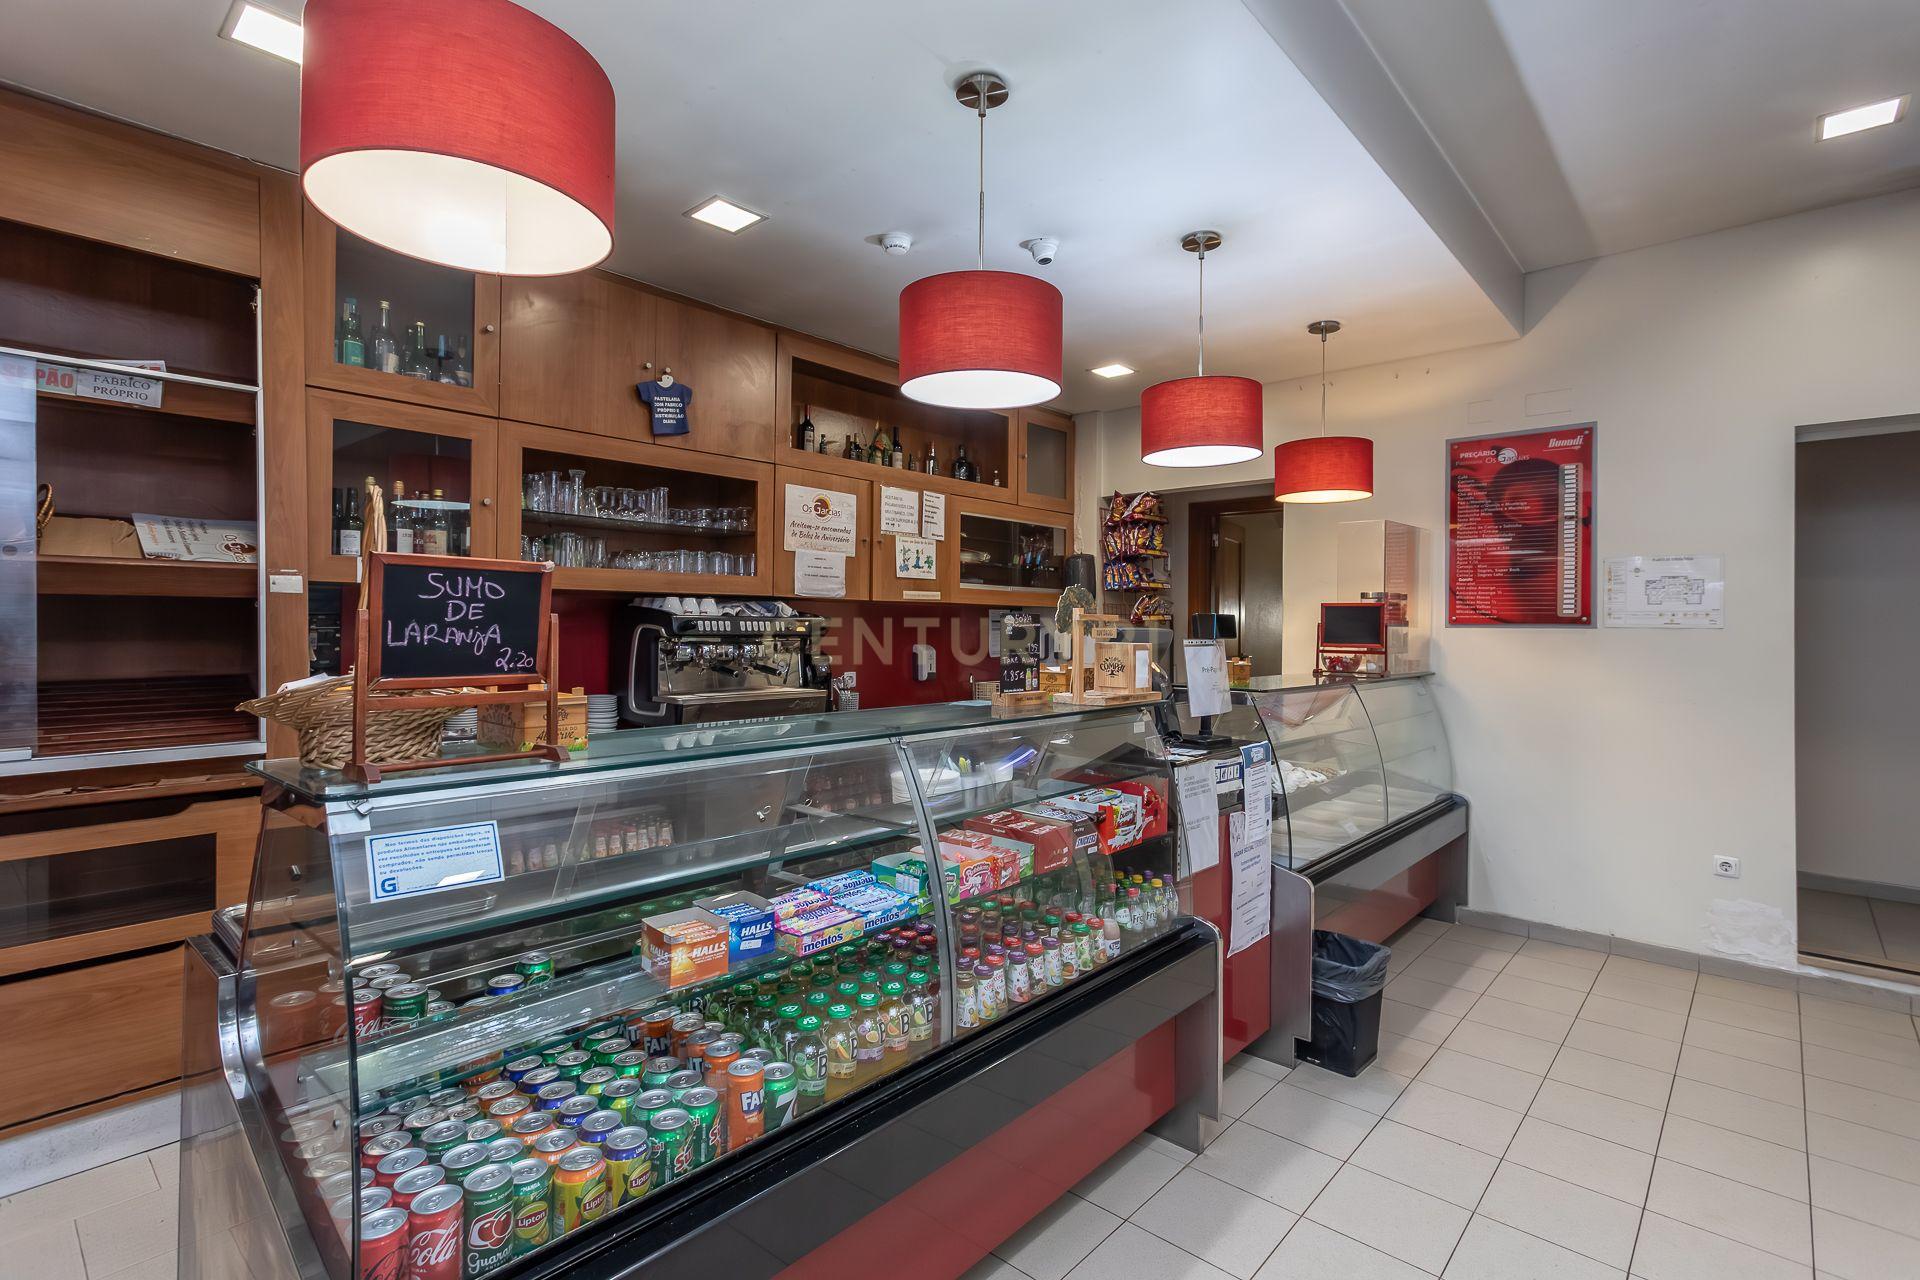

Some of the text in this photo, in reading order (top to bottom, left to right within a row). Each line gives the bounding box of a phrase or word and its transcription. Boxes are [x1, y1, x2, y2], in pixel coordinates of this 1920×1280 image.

[36, 367, 74, 389] PÃO
[93, 374, 150, 391] FABRICO
[93, 385, 148, 400] PRÓPRIO
[802, 502, 841, 517] Os Garcias
[790, 520, 852, 535] Aceitam-se encomendas
[791, 529, 850, 543] de Bolos de Aniversário
[418, 573, 505, 599] SUMO
[445, 600, 485, 622] DE
[387, 620, 501, 655] LARANJA
[380, 876, 397, 893] G
[864, 910, 900, 929] mentos
[740, 921, 773, 937] HALLS
[691, 941, 728, 958] HALLS
[803, 932, 843, 954] mentos
[518, 1211, 546, 1228] Lipton
